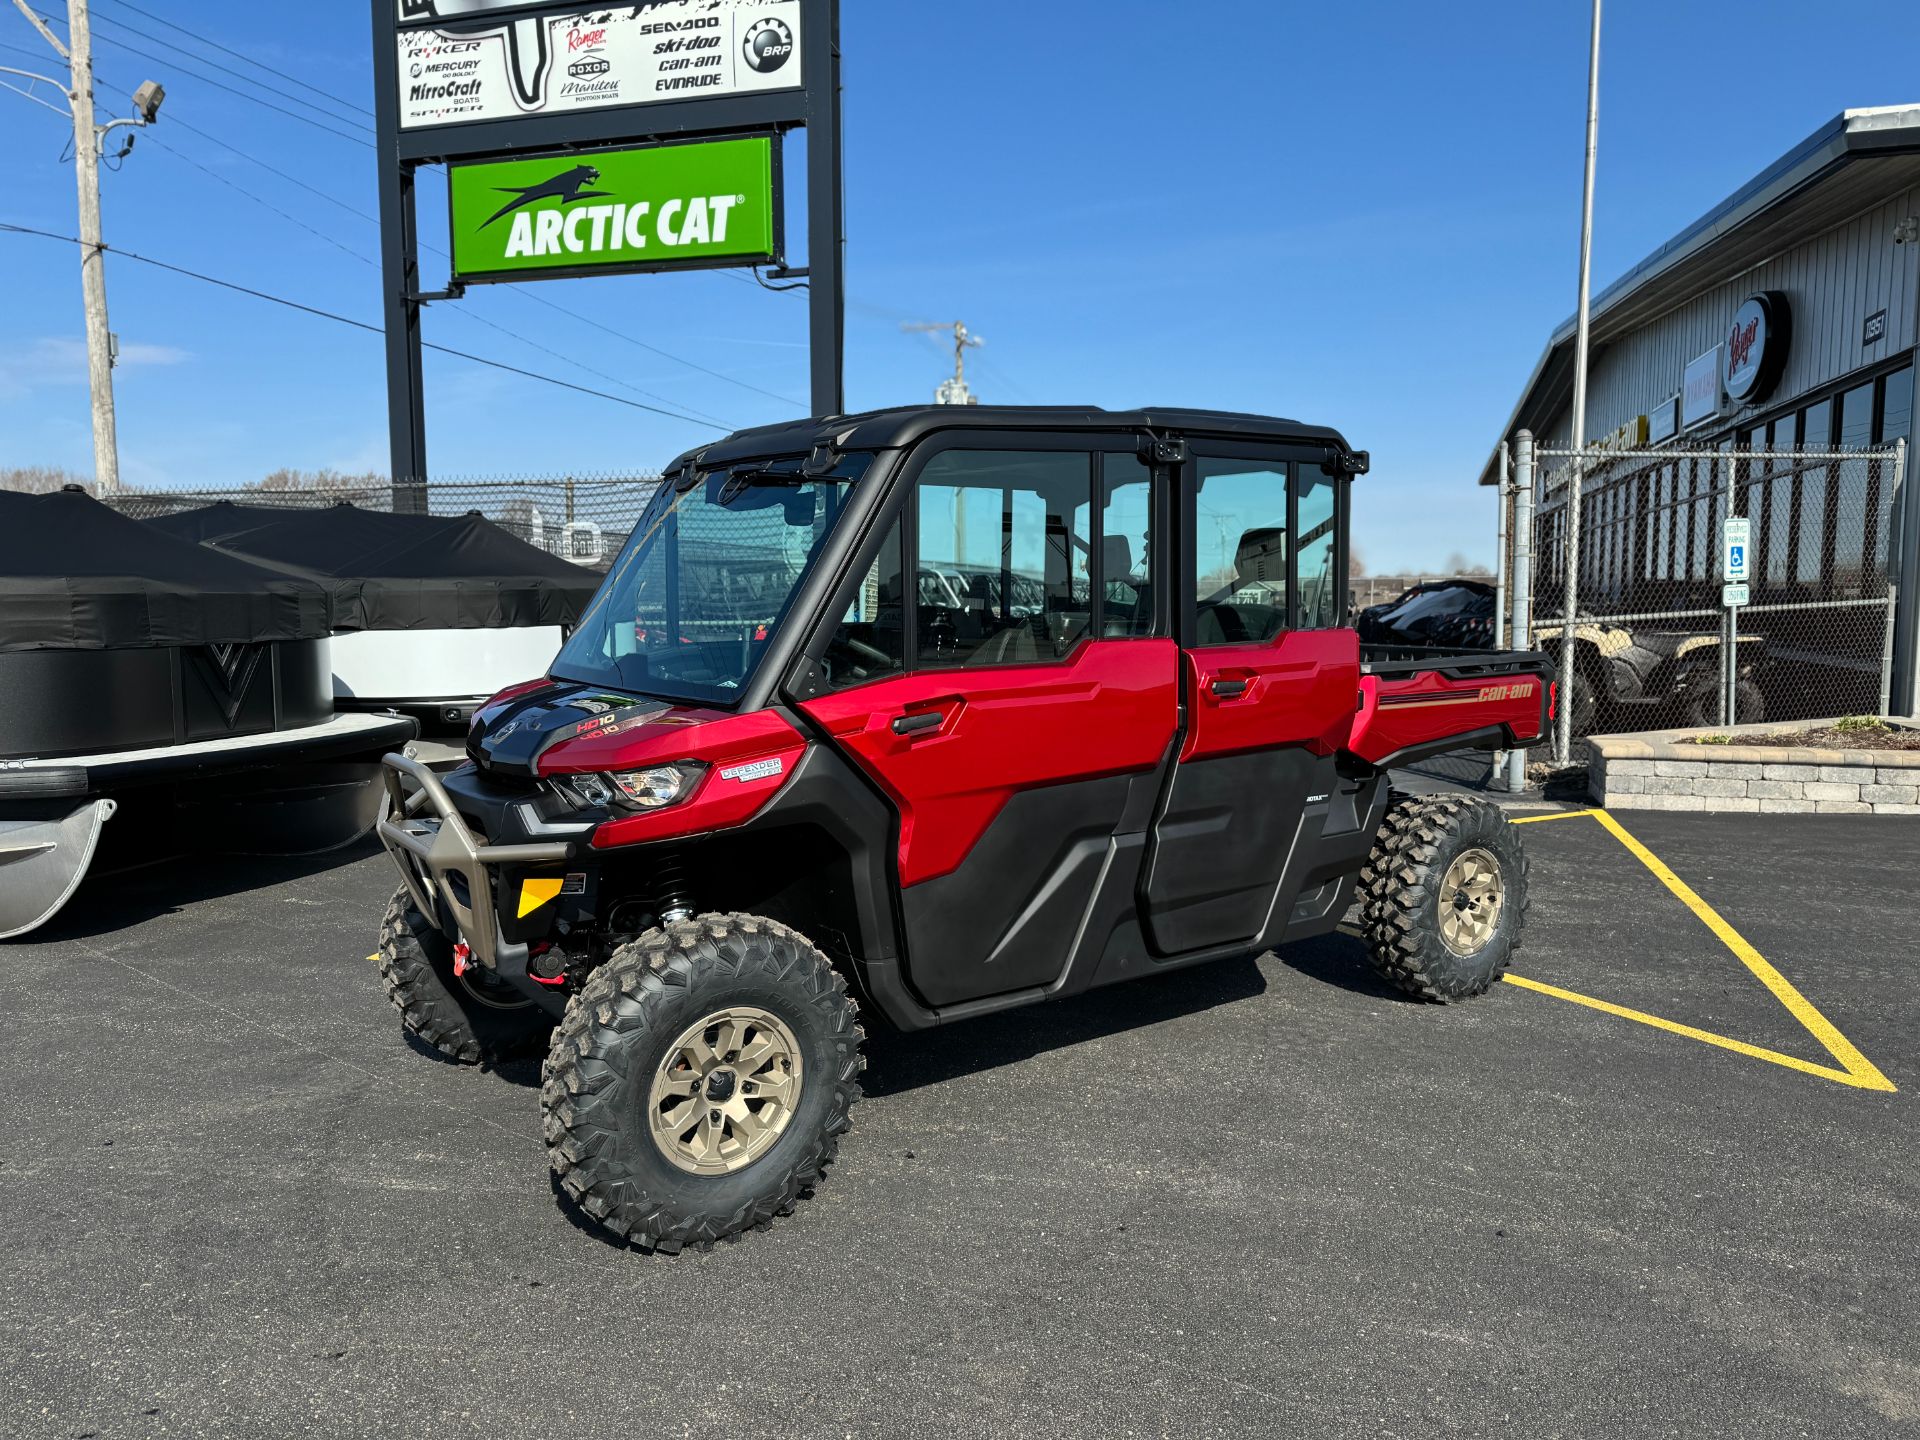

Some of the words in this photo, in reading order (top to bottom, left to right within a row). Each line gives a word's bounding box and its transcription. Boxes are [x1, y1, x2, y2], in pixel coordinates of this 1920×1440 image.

[566, 28, 605, 53] Ranger
[653, 36, 720, 54] ski-doo
[408, 42, 481, 58] RYKER
[762, 45, 791, 57] BRP
[425, 60, 481, 73] MERCURY
[569, 62, 609, 75] ROXOR
[658, 55, 721, 71] can-am
[409, 79, 482, 101] MirroCraft
[560, 80, 619, 94] Manitou
[655, 73, 722, 91] EVINRUDE
[409, 105, 483, 117] SPYDER
[504, 202, 650, 257] ARCTIC
[1728, 317, 1759, 381] Ranger
[1479, 683, 1533, 702] can-am
[577, 713, 615, 733] HD10
[722, 759, 780, 778] DEFENDER
